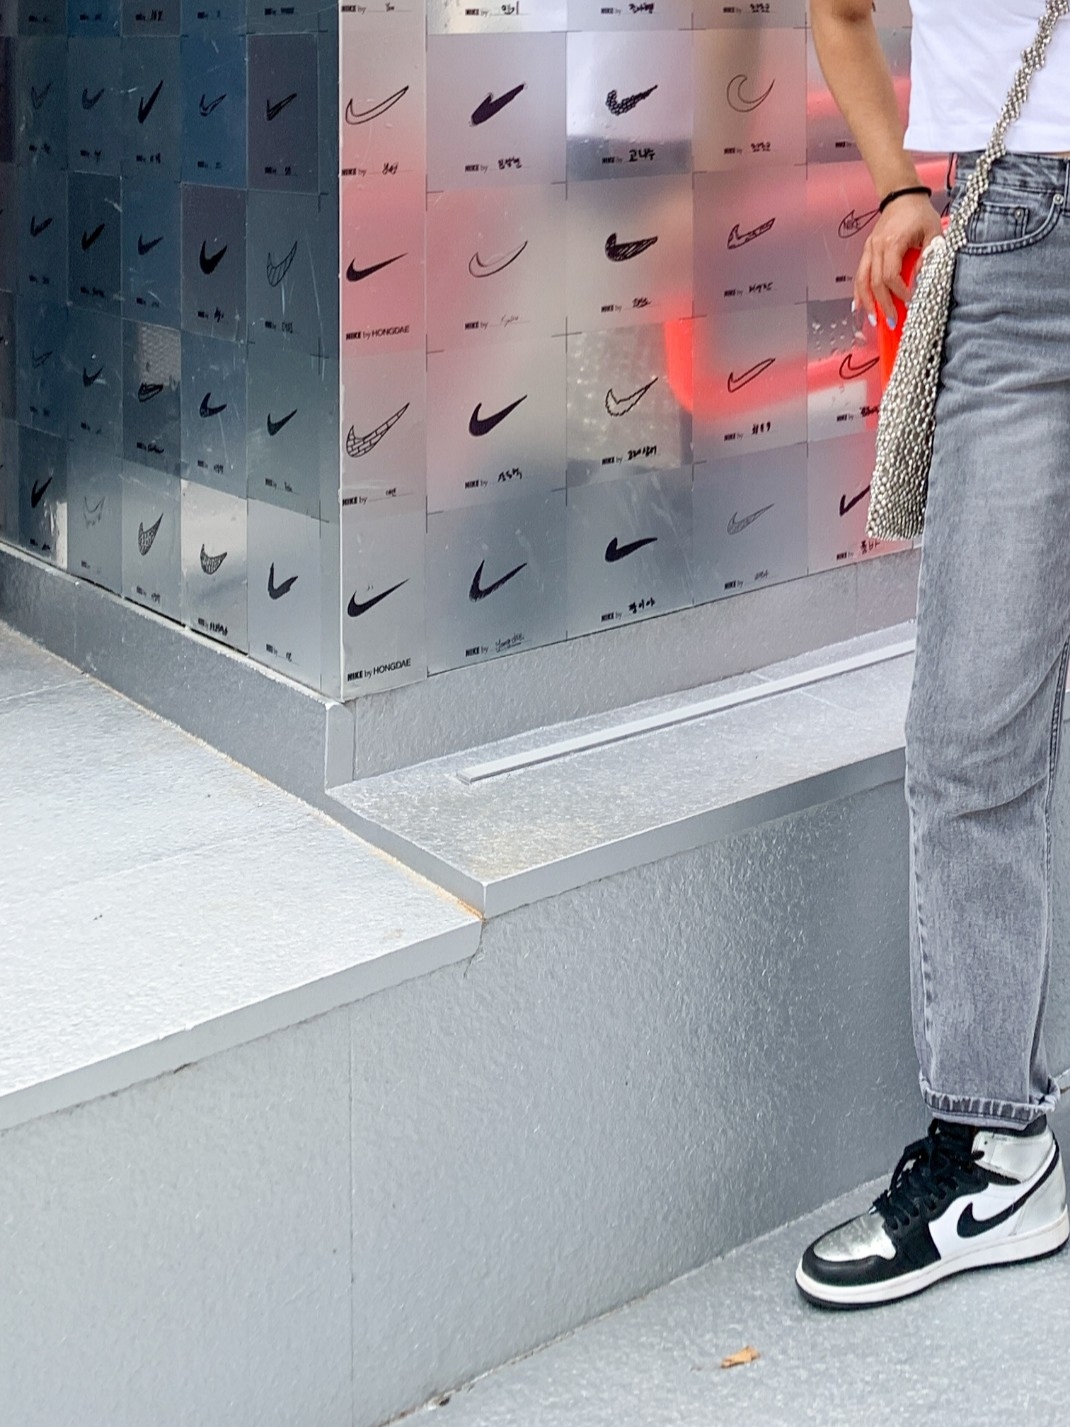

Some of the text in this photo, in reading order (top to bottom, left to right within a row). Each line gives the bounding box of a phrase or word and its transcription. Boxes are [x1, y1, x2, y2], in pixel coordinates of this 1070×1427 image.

[465, 322, 479, 330] NIKE
[346, 332, 361, 340] NIKE
[372, 325, 409, 337] HONGDAE
[465, 480, 479, 489] NIKE
[342, 497, 357, 506] NIKE
[466, 647, 480, 657] NIKE
[348, 671, 362, 681] NIKE
[373, 658, 411, 675] HONGDAE
